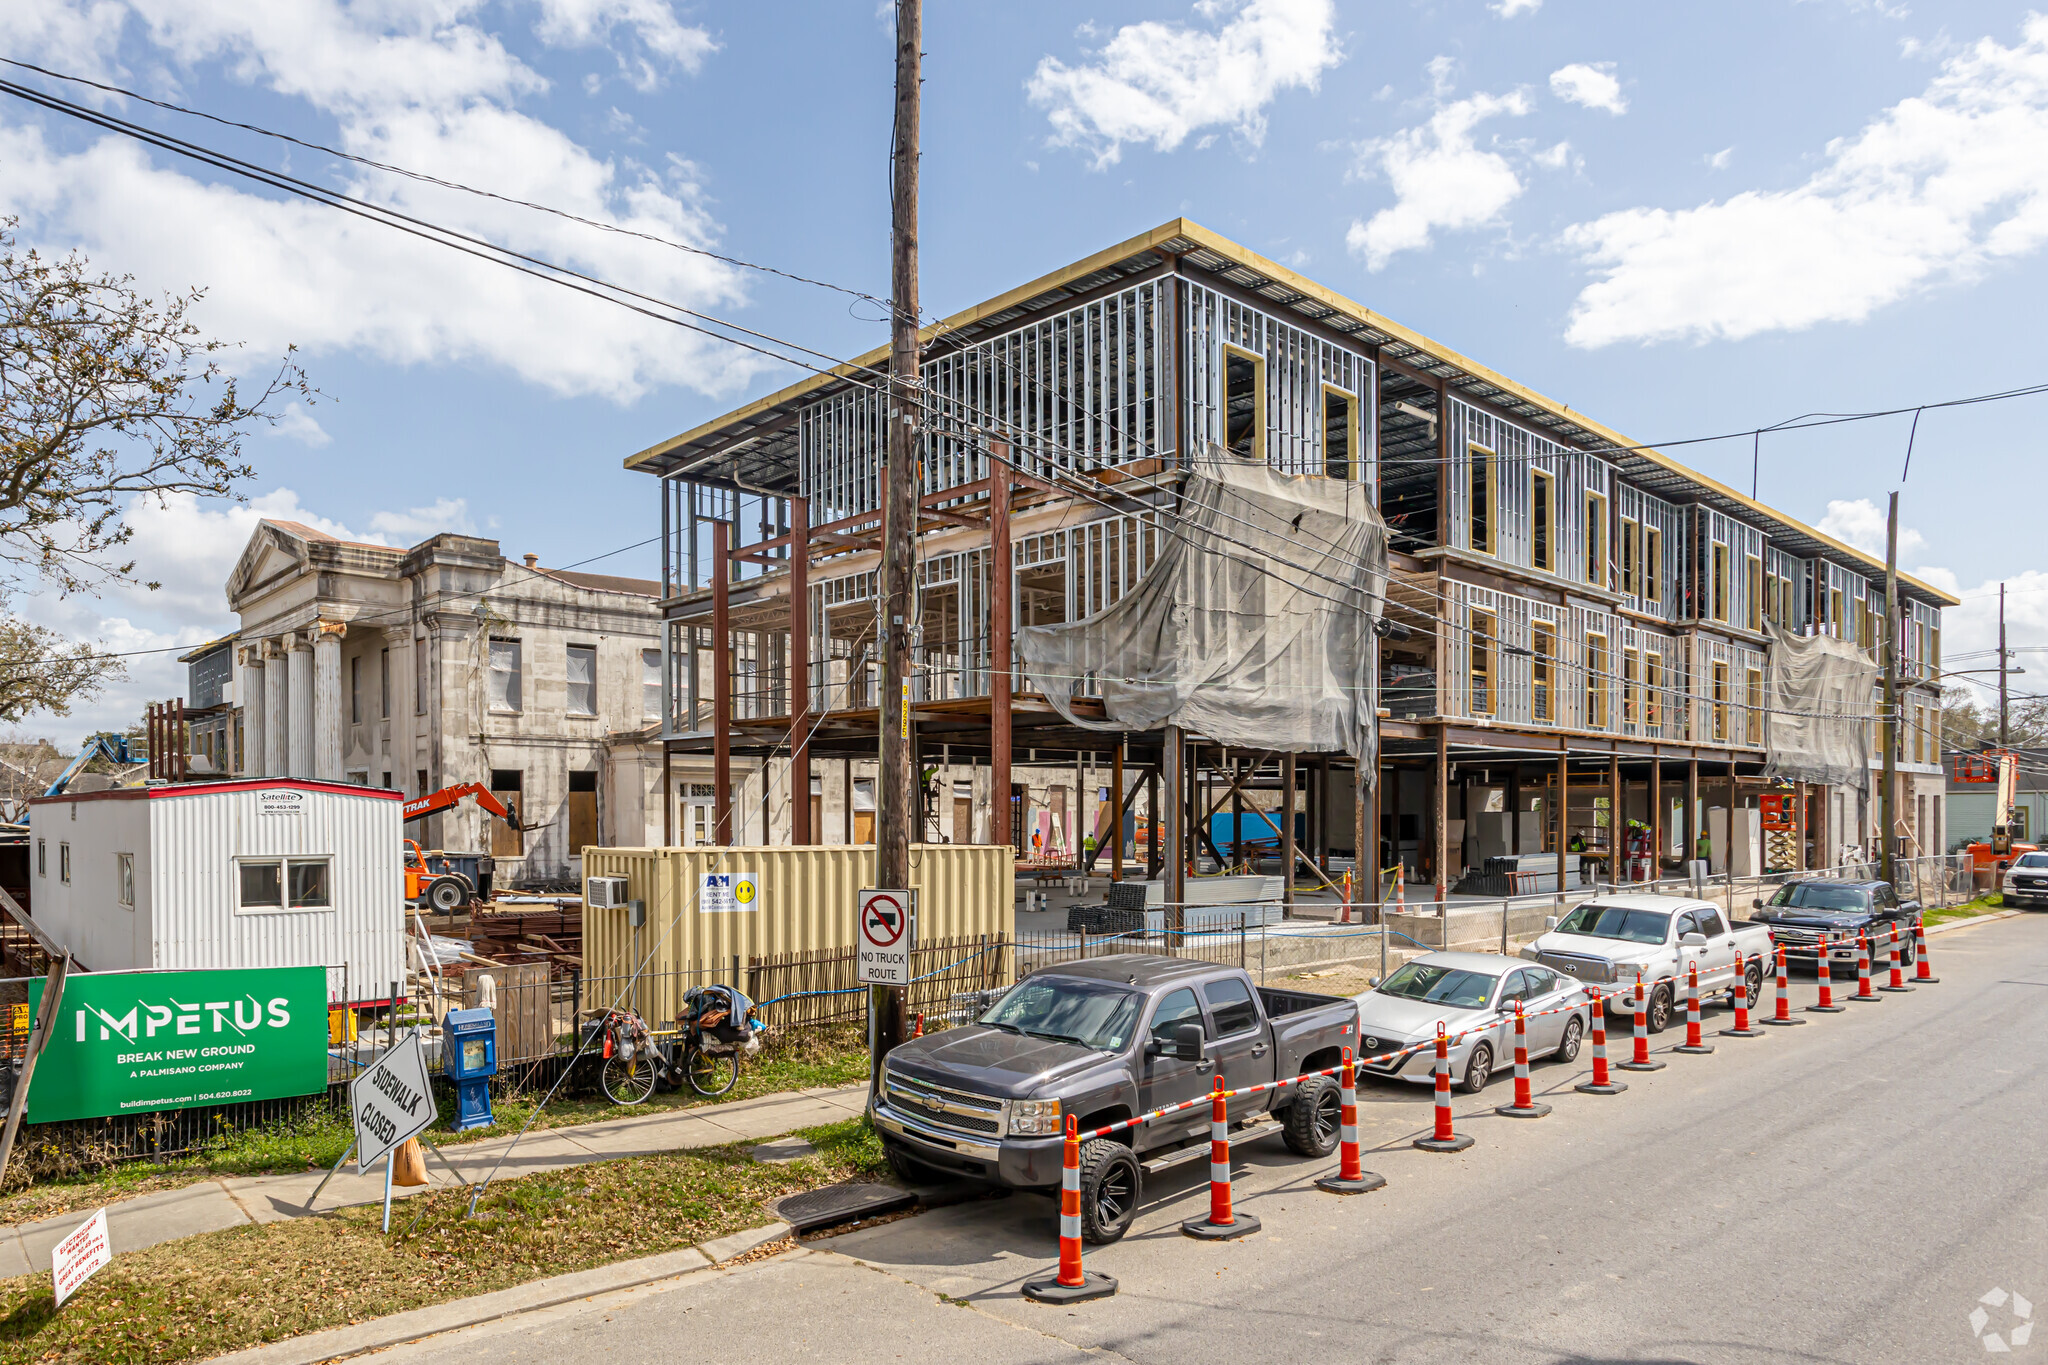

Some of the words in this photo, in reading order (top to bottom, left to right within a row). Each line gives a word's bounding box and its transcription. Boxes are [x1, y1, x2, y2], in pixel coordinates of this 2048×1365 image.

[902, 685, 908, 695] 3
[260, 792, 297, 801] Satellite
[403, 798, 430, 813] TRAK
[706, 875, 730, 887] A&M
[861, 952, 873, 962] NO
[875, 952, 905, 964] TRUCK
[868, 968, 897, 980] ROUTE
[76, 994, 291, 1045] IMPETUS
[117, 1051, 163, 1064] BREAK
[166, 1048, 198, 1060] NEW
[201, 1044, 256, 1057] GROUND
[140, 1066, 196, 1077] PALMISANO
[198, 1062, 244, 1072] COMPANY
[120, 1095, 192, 1108] buildimpetus.com
[198, 1089, 252, 1100] 504.620.8022
[372, 1064, 423, 1117] SIDEWALK
[360, 1102, 397, 1145] CLOSED
[59, 1218, 97, 1255] ELECTRICIANS
[66, 1232, 90, 1255] WANTED
[58, 1264, 74, 1286] GREAT
[75, 1242, 105, 1269] BENEFITS
